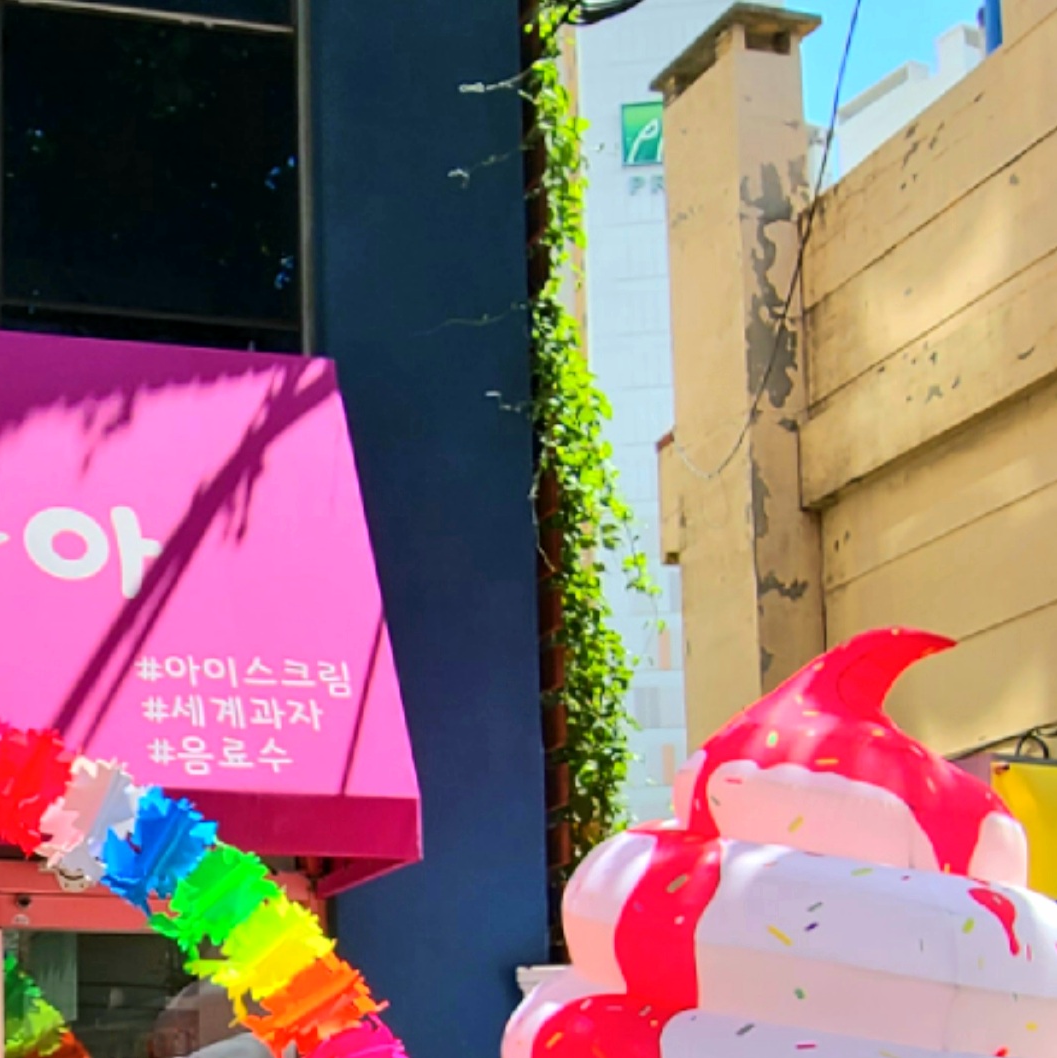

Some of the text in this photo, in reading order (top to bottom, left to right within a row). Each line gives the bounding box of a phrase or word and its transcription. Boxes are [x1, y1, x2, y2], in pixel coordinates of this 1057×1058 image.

[135, 655, 352, 698] #아이스크림
[142, 694, 323, 731] #세계과자
[148, 735, 293, 776] #음료수
